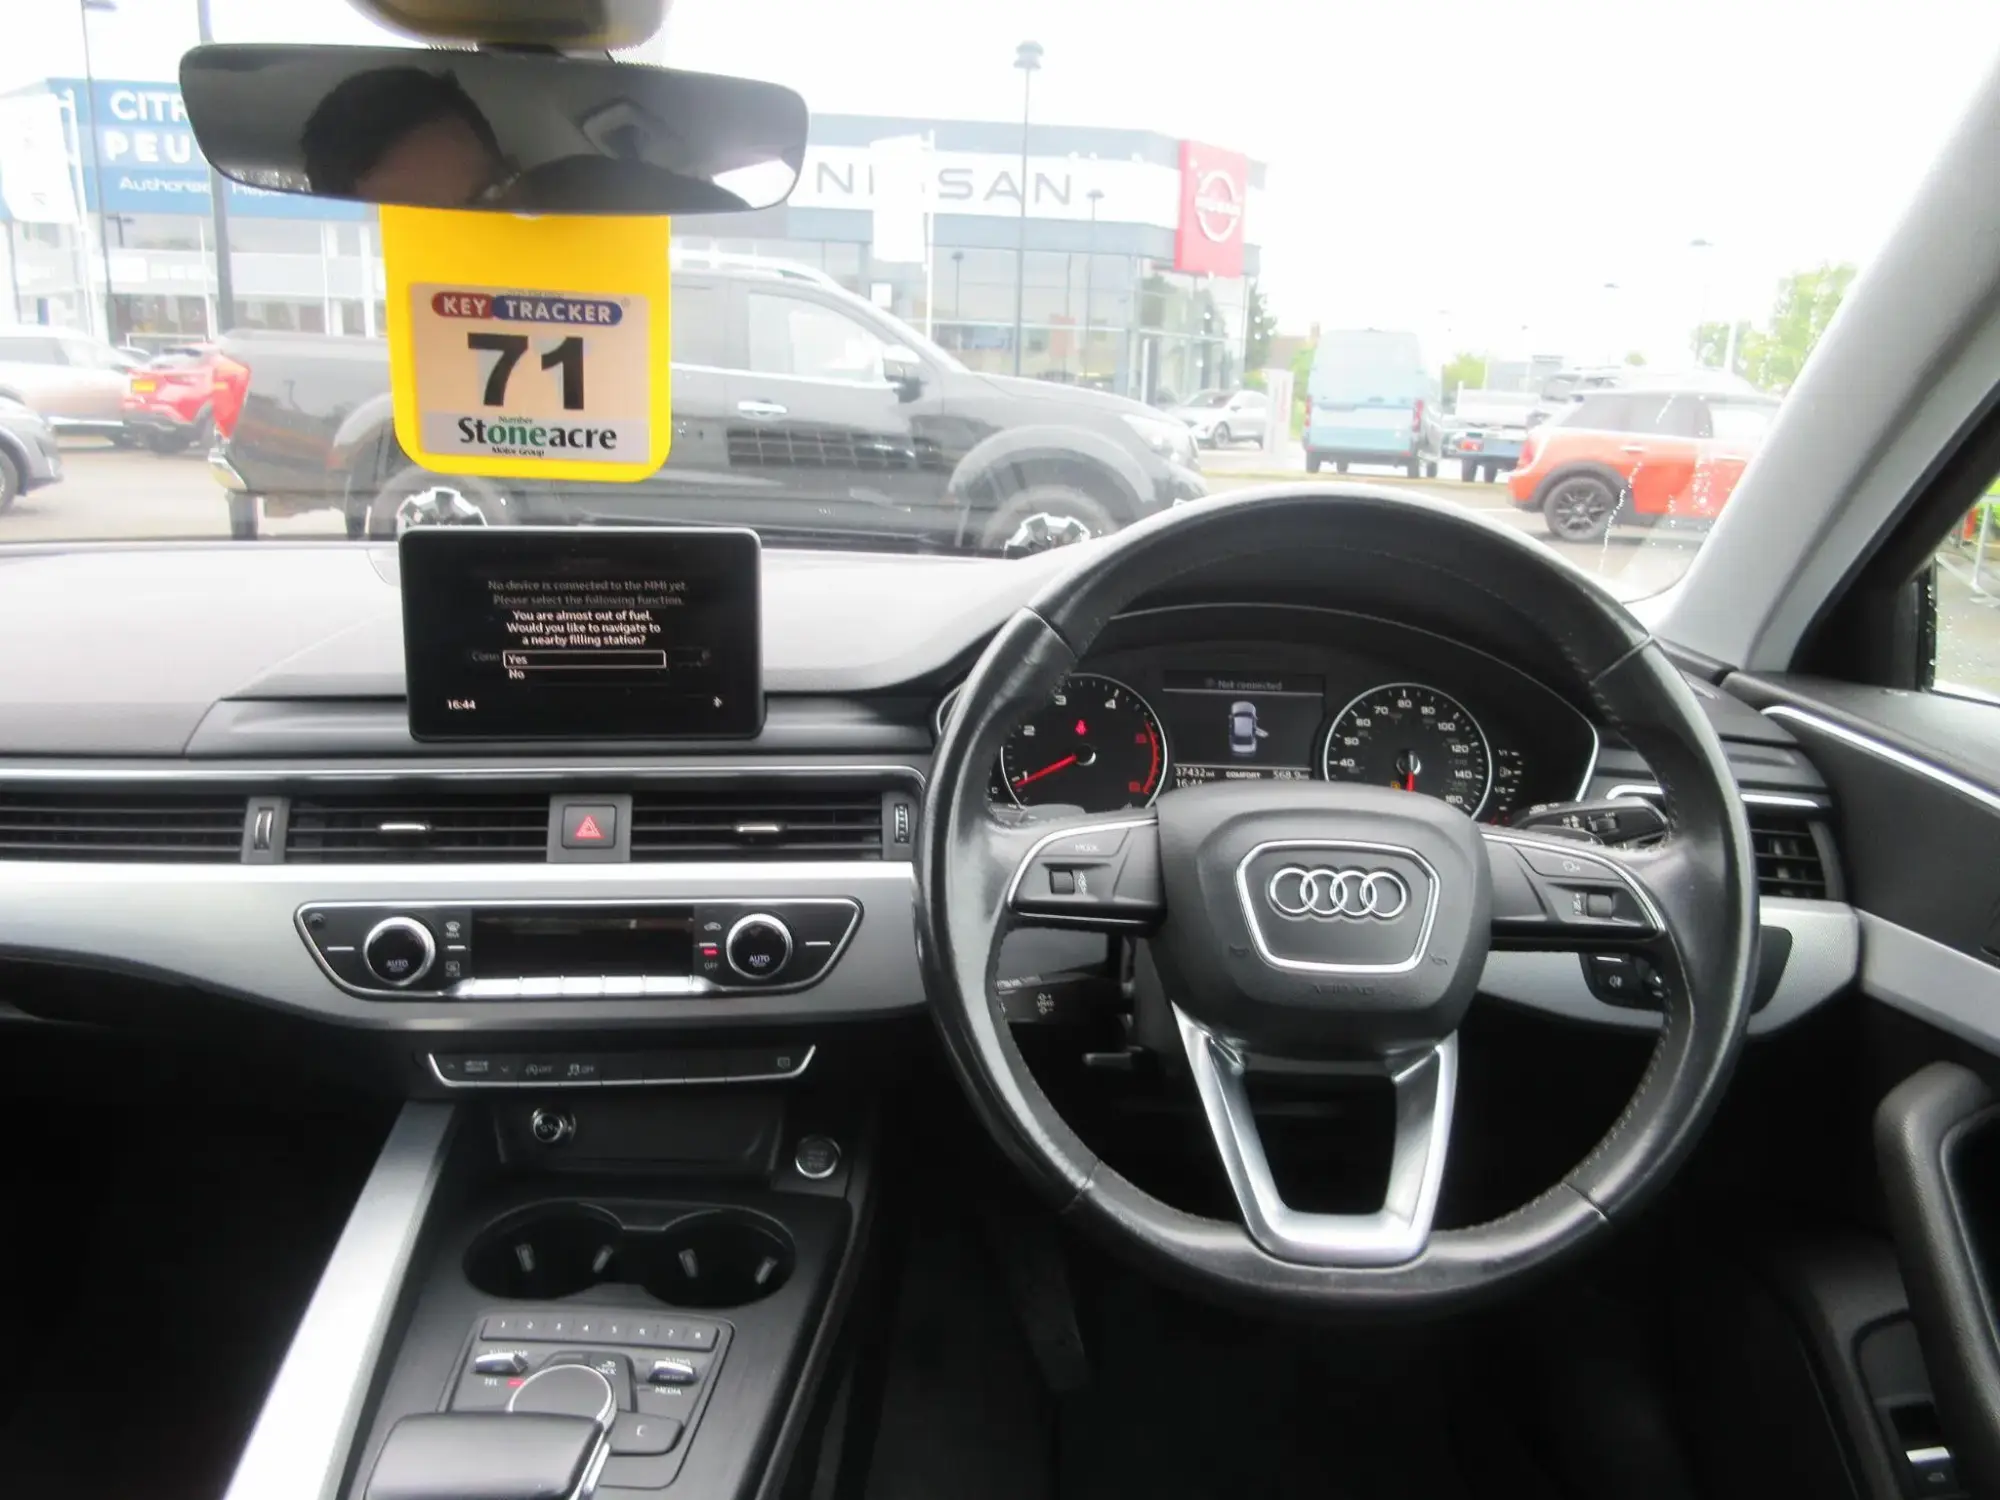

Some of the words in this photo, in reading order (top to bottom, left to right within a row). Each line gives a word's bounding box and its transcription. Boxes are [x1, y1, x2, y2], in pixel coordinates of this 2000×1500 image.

[443, 297, 487, 316] KEY
[506, 300, 612, 323] TRACKER
[467, 332, 584, 411] 71
[458, 417, 617, 450] Stoneacre
[491, 446, 517, 456] Motor
[519, 447, 545, 459] Group
[512, 610, 534, 621] You
[536, 612, 554, 621] are
[556, 610, 592, 621] almost
[595, 611, 613, 621] out
[615, 610, 627, 621] of
[629, 610, 653, 621] fuel.
[506, 622, 543, 633] Would
[545, 623, 564, 635] you
[567, 622, 585, 633] like
[588, 622, 600, 633] to
[602, 622, 648, 635] navigate
[649, 622, 661, 633] to
[531, 634, 567, 648] nearby
[569, 634, 602, 647] filling
[603, 634, 646, 646] station?
[508, 654, 527, 665] Yes
[508, 669, 526, 680] No
[1218, 680, 1234, 690] Not
[1236, 681, 1282, 690] connected
[1104, 699, 1116, 709] 4
[1374, 705, 1389, 716] 70
[1437, 721, 1456, 732] 100
[1451, 744, 1470, 754] 120
[1339, 758, 1356, 768] 40
[1175, 767, 1206, 778] 37432
[1454, 769, 1473, 780] 140
[386, 959, 409, 969] AUTO
[750, 954, 771, 964] AUTO
